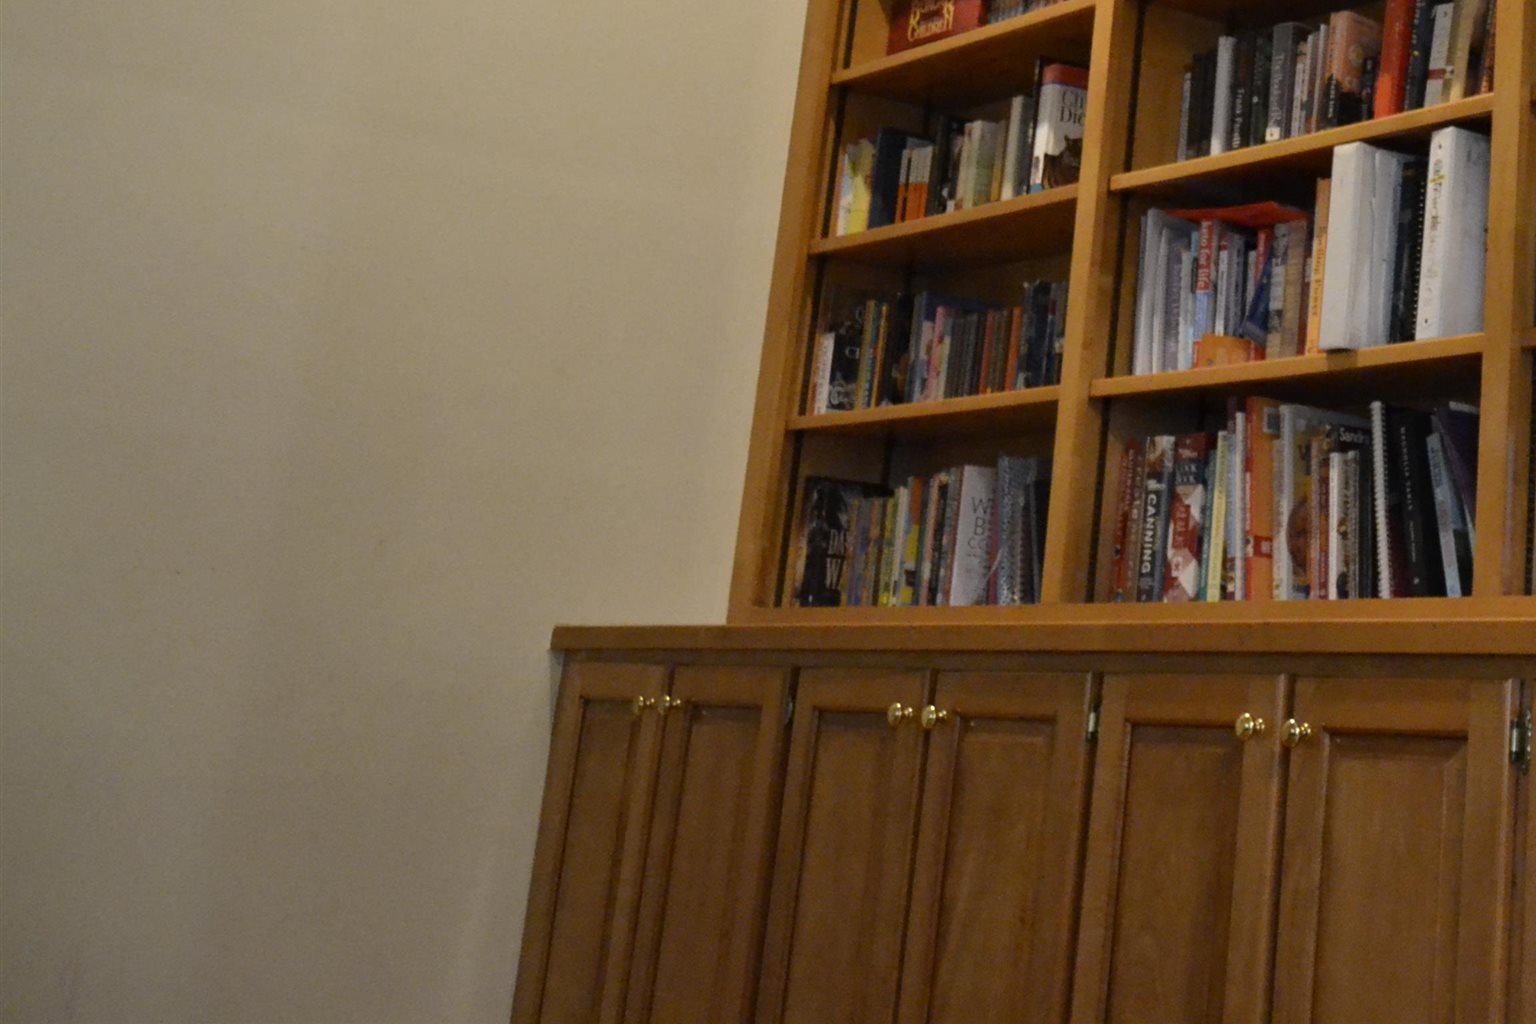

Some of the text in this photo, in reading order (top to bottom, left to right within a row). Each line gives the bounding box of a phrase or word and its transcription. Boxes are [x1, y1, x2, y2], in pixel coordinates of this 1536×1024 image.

[1197, 221, 1211, 288] keto for life
[1399, 427, 1410, 478] MAGNOLIA
[1141, 494, 1158, 575] CANNING
